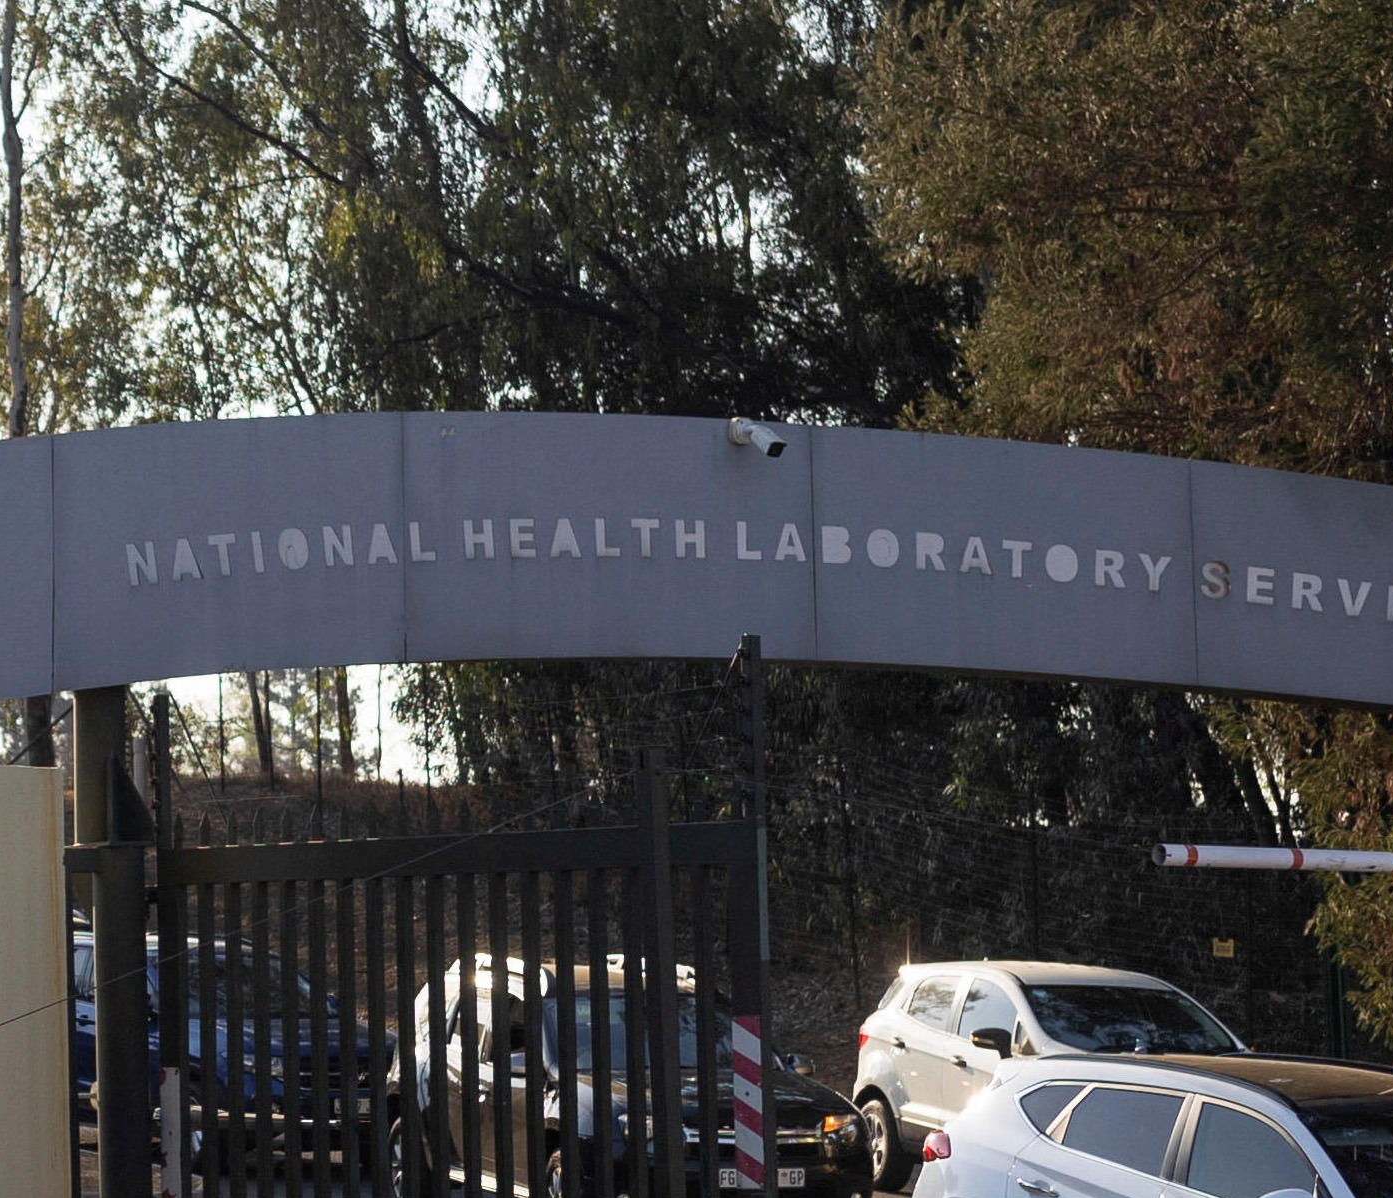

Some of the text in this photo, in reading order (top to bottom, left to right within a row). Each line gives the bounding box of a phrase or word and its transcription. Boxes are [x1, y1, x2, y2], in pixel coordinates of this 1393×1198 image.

[125, 521, 437, 587] NATIONAL
[463, 517, 707, 560] HEALTH
[735, 520, 1173, 592] LABORATORY
[789, 1170, 804, 1185] GP
